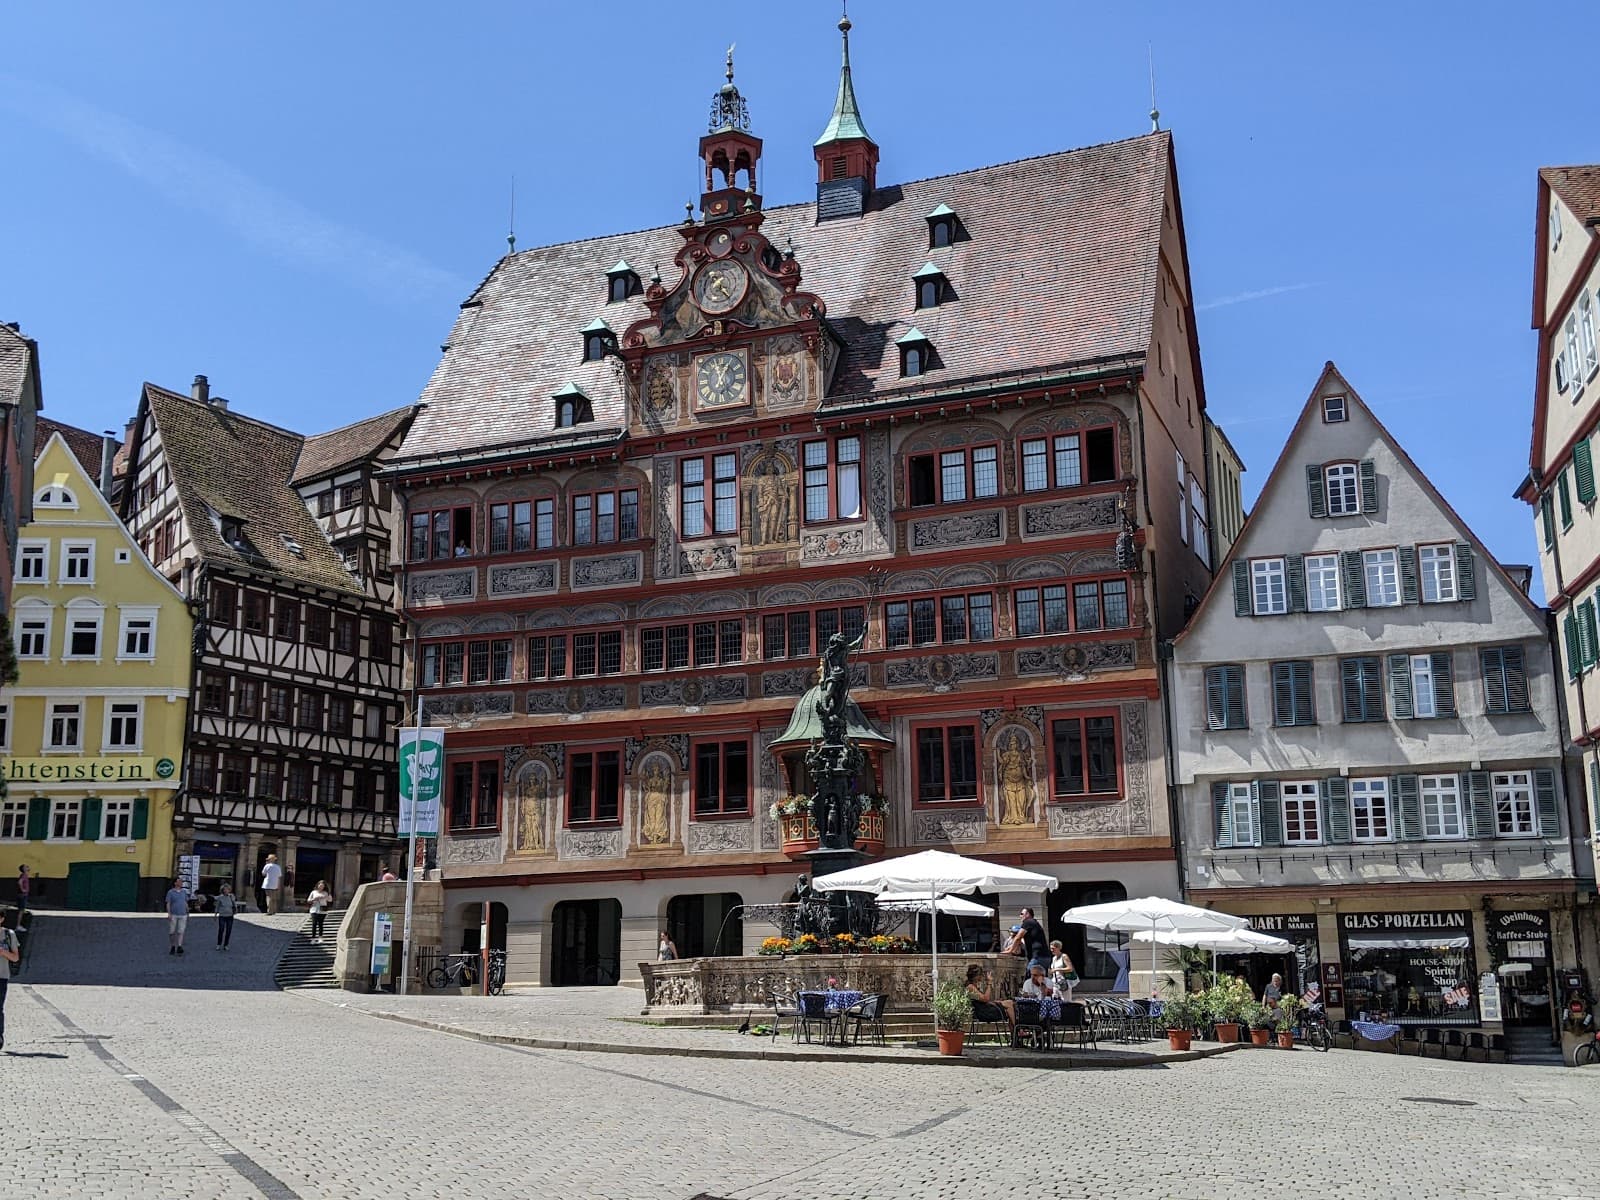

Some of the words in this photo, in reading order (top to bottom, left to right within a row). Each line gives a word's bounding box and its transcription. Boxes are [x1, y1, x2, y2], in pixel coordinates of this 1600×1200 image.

[1247, 916, 1284, 930] UART
[1499, 911, 1544, 926] Weinhaus
[1496, 930, 1548, 940] Kaffee-Stube
[1409, 958, 1465, 966] HOUSE-SHOP
[1424, 966, 1456, 977] Spirits
[1433, 976, 1458, 987] Shop
[1443, 986, 1470, 1005] SALE
